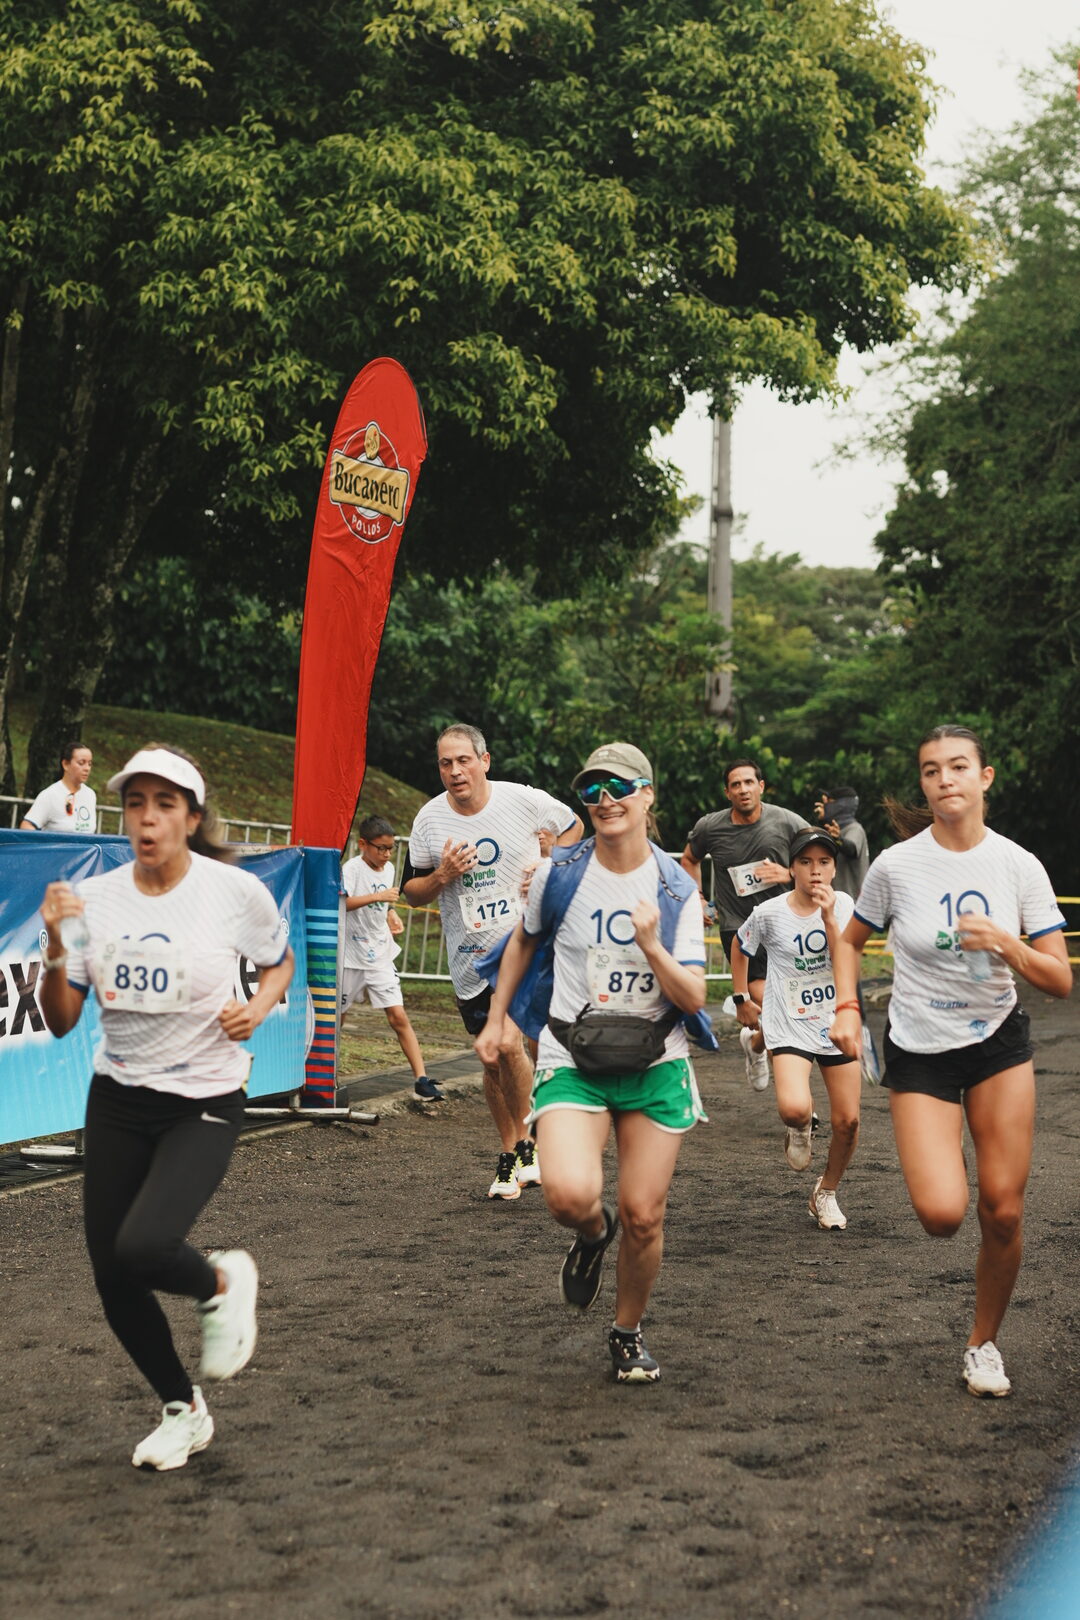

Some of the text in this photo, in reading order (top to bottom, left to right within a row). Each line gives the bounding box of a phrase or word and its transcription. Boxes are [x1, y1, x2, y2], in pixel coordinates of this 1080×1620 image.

[334, 461, 400, 510] Bucanero
[351, 514, 381, 536] POLLOS
[477, 900, 510, 920] 172
[590, 909, 636, 945] 10
[793, 929, 829, 956] 10
[115, 963, 168, 993] 830
[608, 971, 655, 993] 873
[801, 984, 835, 1005] 690
